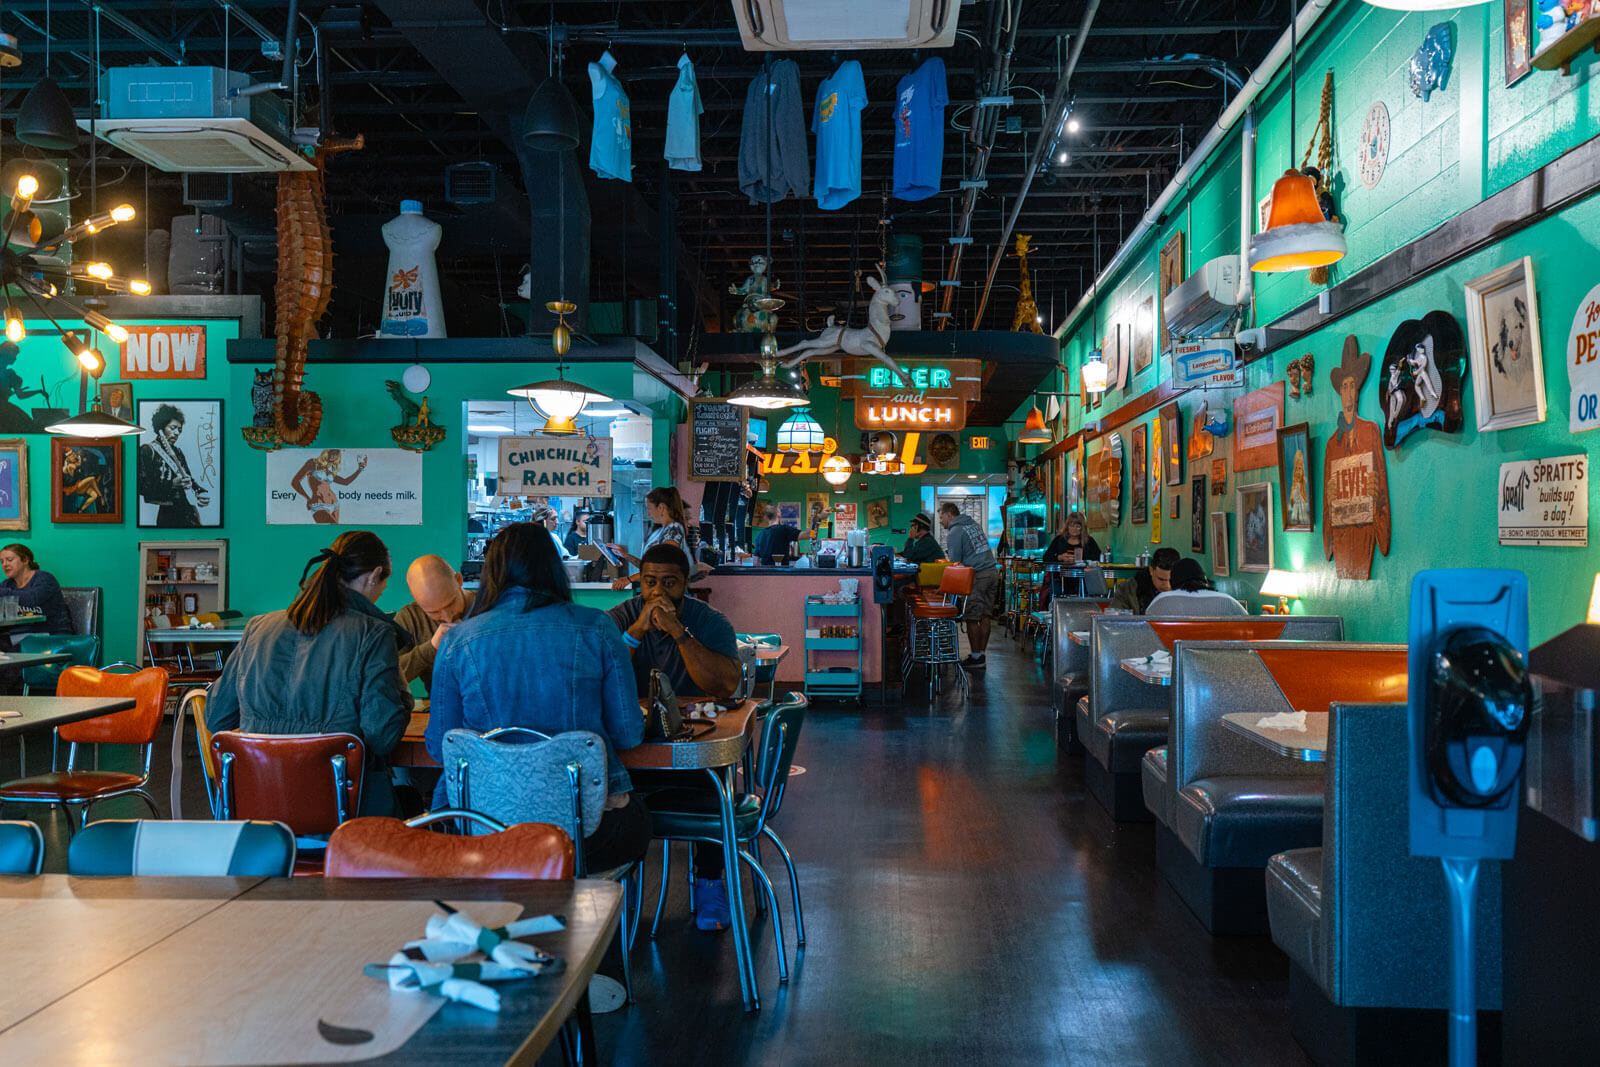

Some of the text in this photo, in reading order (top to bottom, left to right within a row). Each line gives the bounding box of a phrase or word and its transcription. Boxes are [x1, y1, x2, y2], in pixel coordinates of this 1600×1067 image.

[127, 333, 200, 372] NOW
[1575, 331, 1600, 366] PE
[870, 367, 952, 388] BEER
[1212, 374, 1235, 382] FLAVOR
[891, 390, 925, 404] and
[868, 406, 952, 423] LUNCH
[1578, 394, 1598, 423] OR
[971, 436, 988, 449] EXIT
[508, 448, 600, 468] CHINCHILLA
[523, 470, 589, 486] RANCH
[1533, 460, 1584, 483] SPRATT'S
[1337, 462, 1367, 499] LEVI'S
[271, 490, 417, 501] Every body needs milk.
[1543, 510, 1549, 521] a
[1526, 529, 1539, 537] MIXED
[1540, 529, 1554, 537] OVALS
[1557, 529, 1585, 537] WEETMEET
